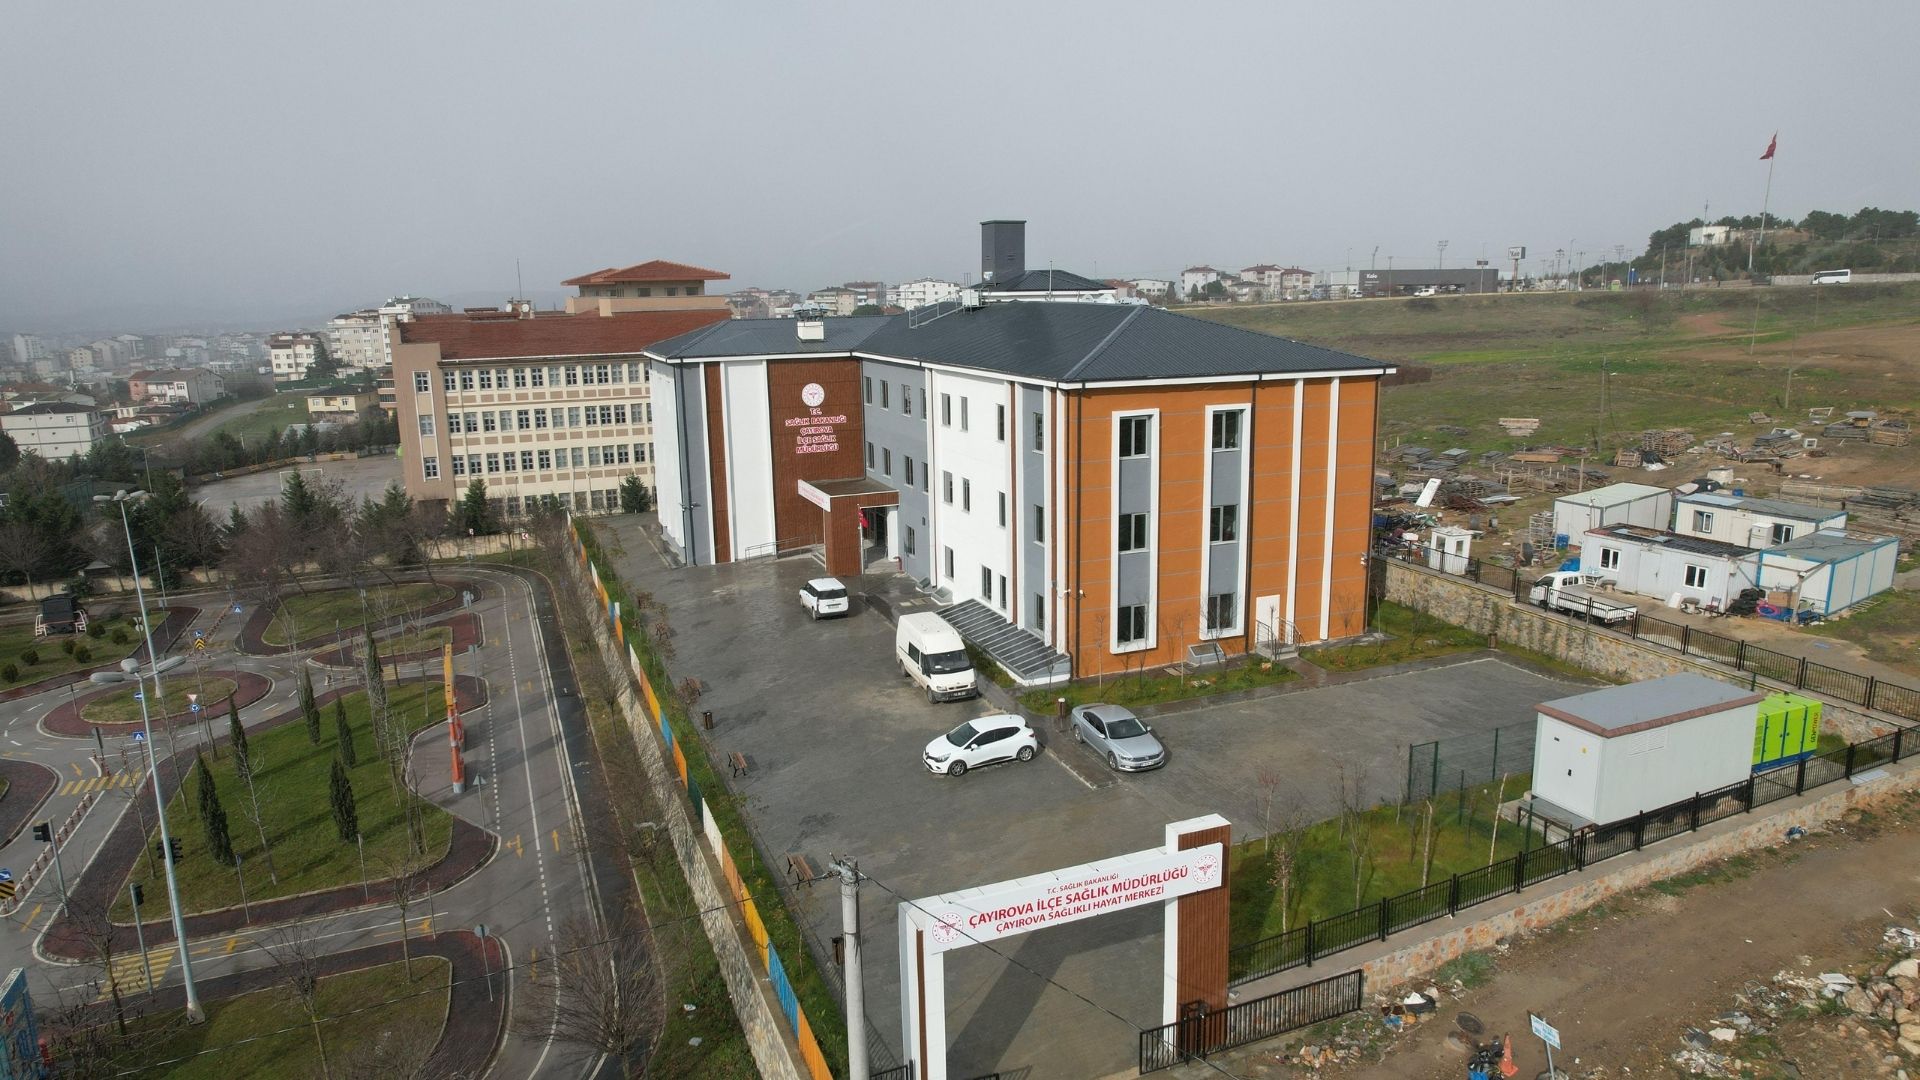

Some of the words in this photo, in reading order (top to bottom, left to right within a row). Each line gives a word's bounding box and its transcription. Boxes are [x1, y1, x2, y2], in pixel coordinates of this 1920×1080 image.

[969, 903, 1034, 929] ÇAYIROVA
[1037, 896, 1062, 911] İLÇE
[1066, 886, 1109, 905] SAĞLIK
[1112, 865, 1188, 893] MÜDÜRLÜĞÜ
[1060, 881, 1083, 892] SAĞLIK
[1084, 873, 1119, 887] BAKANLIĞI
[996, 914, 1046, 934] ÇAYIROVA
[1048, 903, 1091, 920] SAĞLIKLI
[1093, 895, 1122, 909] HAYAT
[1125, 886, 1164, 902] MERKEZİ
